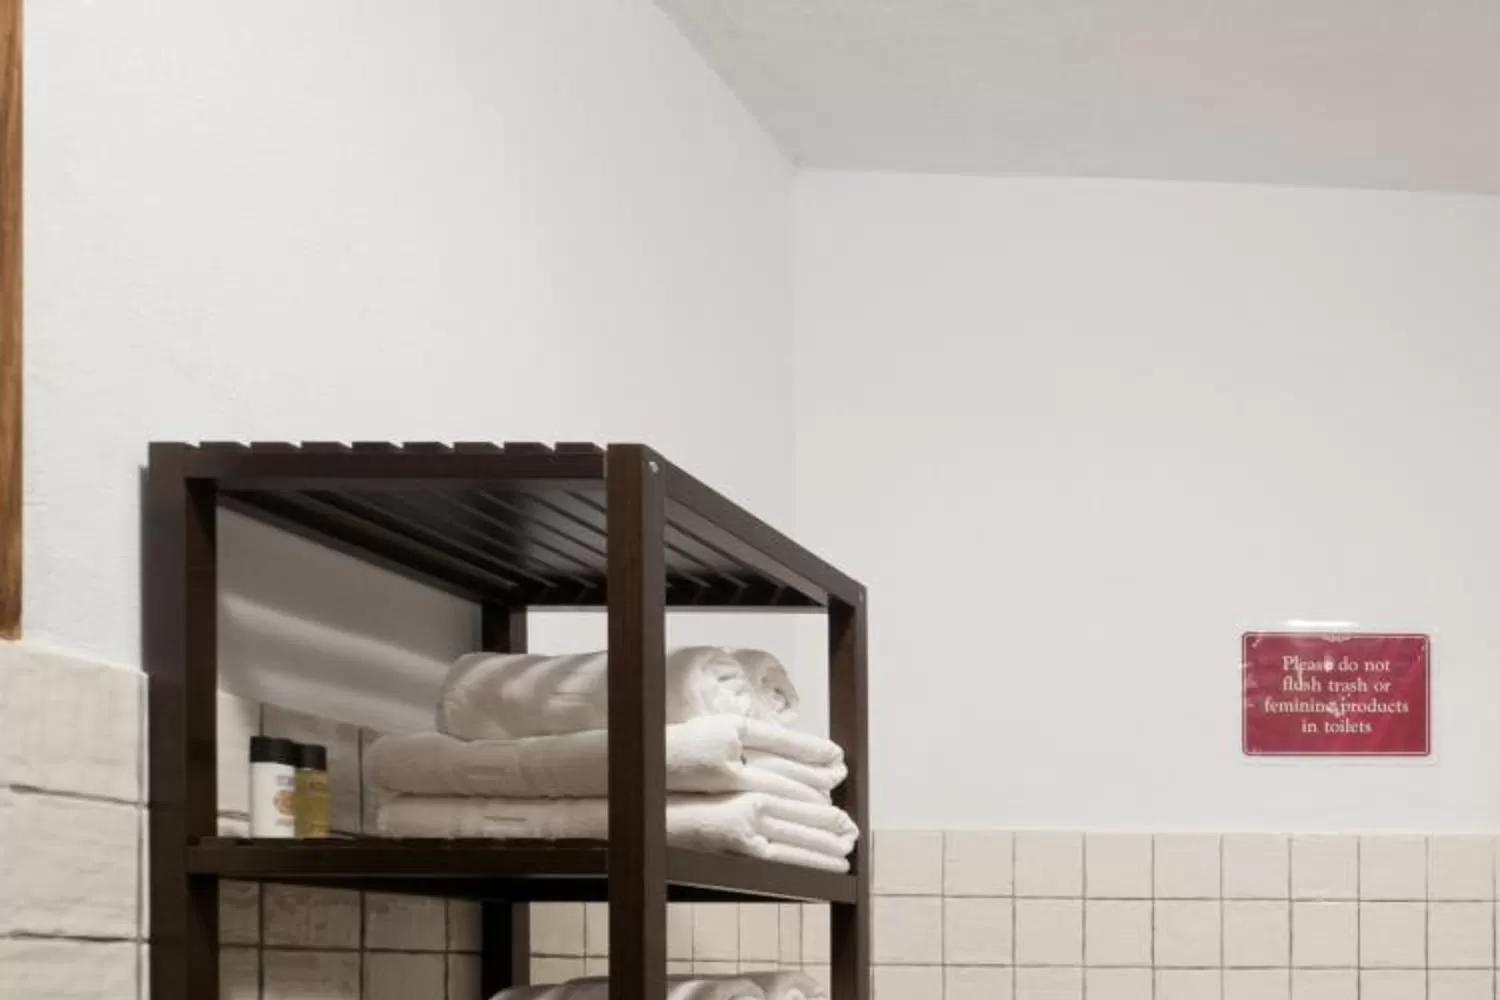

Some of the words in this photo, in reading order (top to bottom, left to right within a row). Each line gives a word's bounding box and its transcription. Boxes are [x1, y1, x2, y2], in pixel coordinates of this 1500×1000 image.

[1282, 655, 1333, 672] Please
[1338, 656, 1359, 672] do
[1364, 660, 1391, 672] not
[1282, 675, 1322, 692] flush
[1328, 677, 1368, 693] trash
[1374, 681, 1392, 693] or
[1264, 696, 1337, 713] feminine
[1341, 698, 1409, 718] products
[1301, 719, 1317, 733] in
